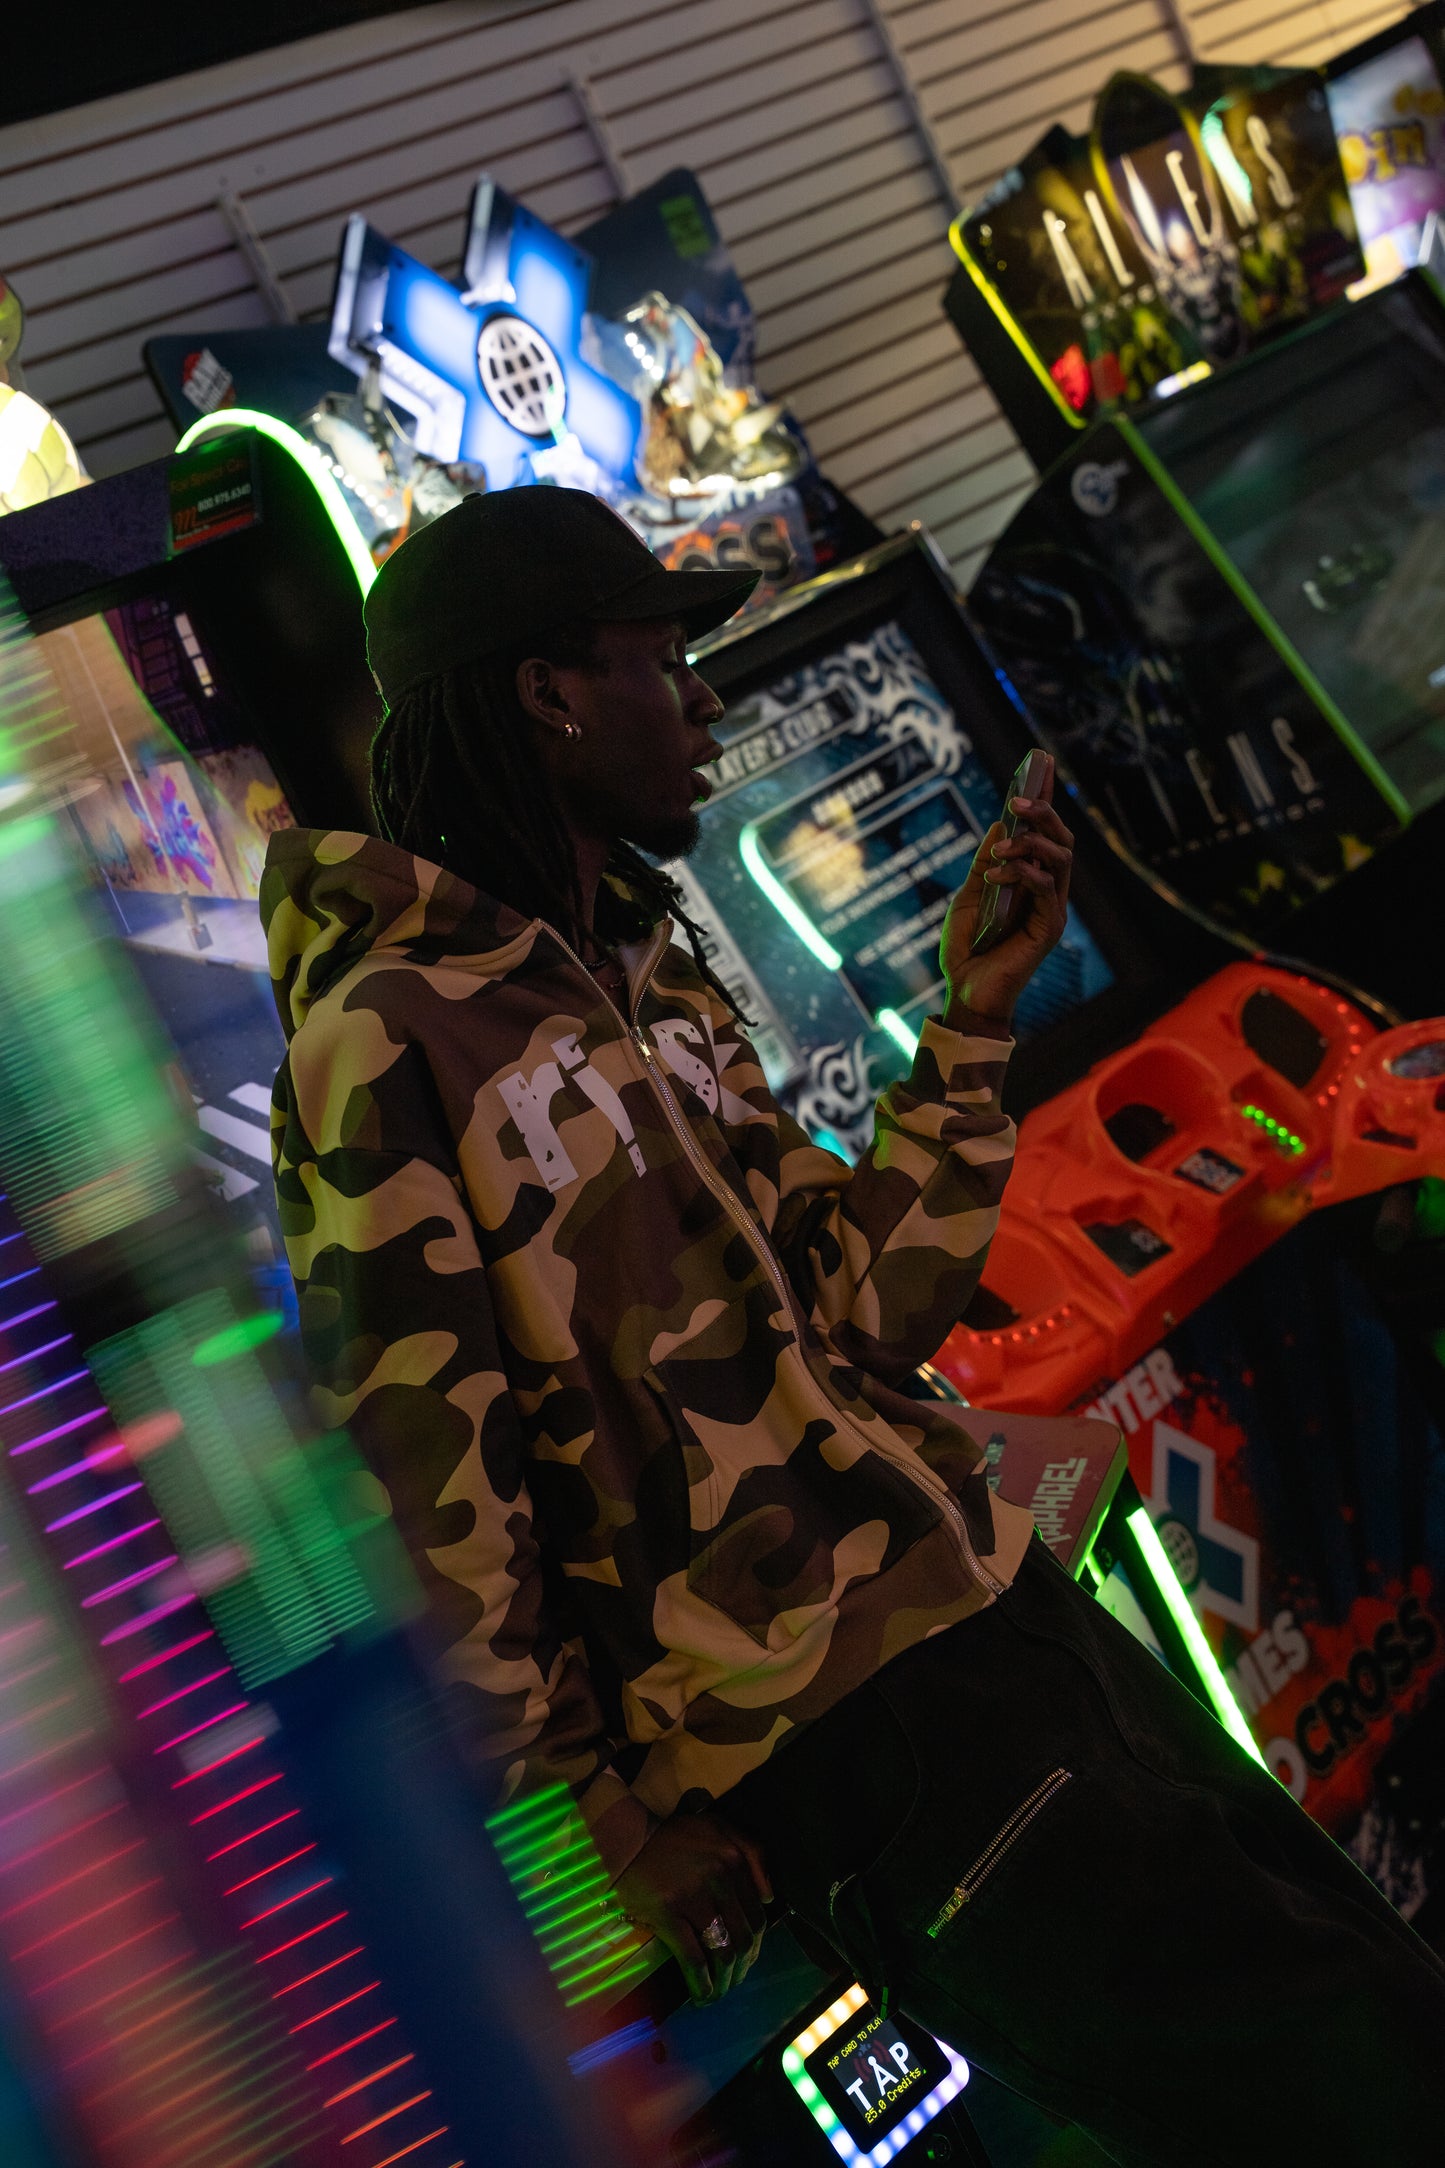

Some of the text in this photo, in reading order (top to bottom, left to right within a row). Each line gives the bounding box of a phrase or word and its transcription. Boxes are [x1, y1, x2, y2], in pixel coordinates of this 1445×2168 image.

[827, 2055, 840, 2070] TAP
[840, 2039, 858, 2058] CARD
[857, 2030, 868, 2042] TO
[845, 2041, 909, 2111] TAP
[864, 2067, 922, 2124] 25.0 Credits
